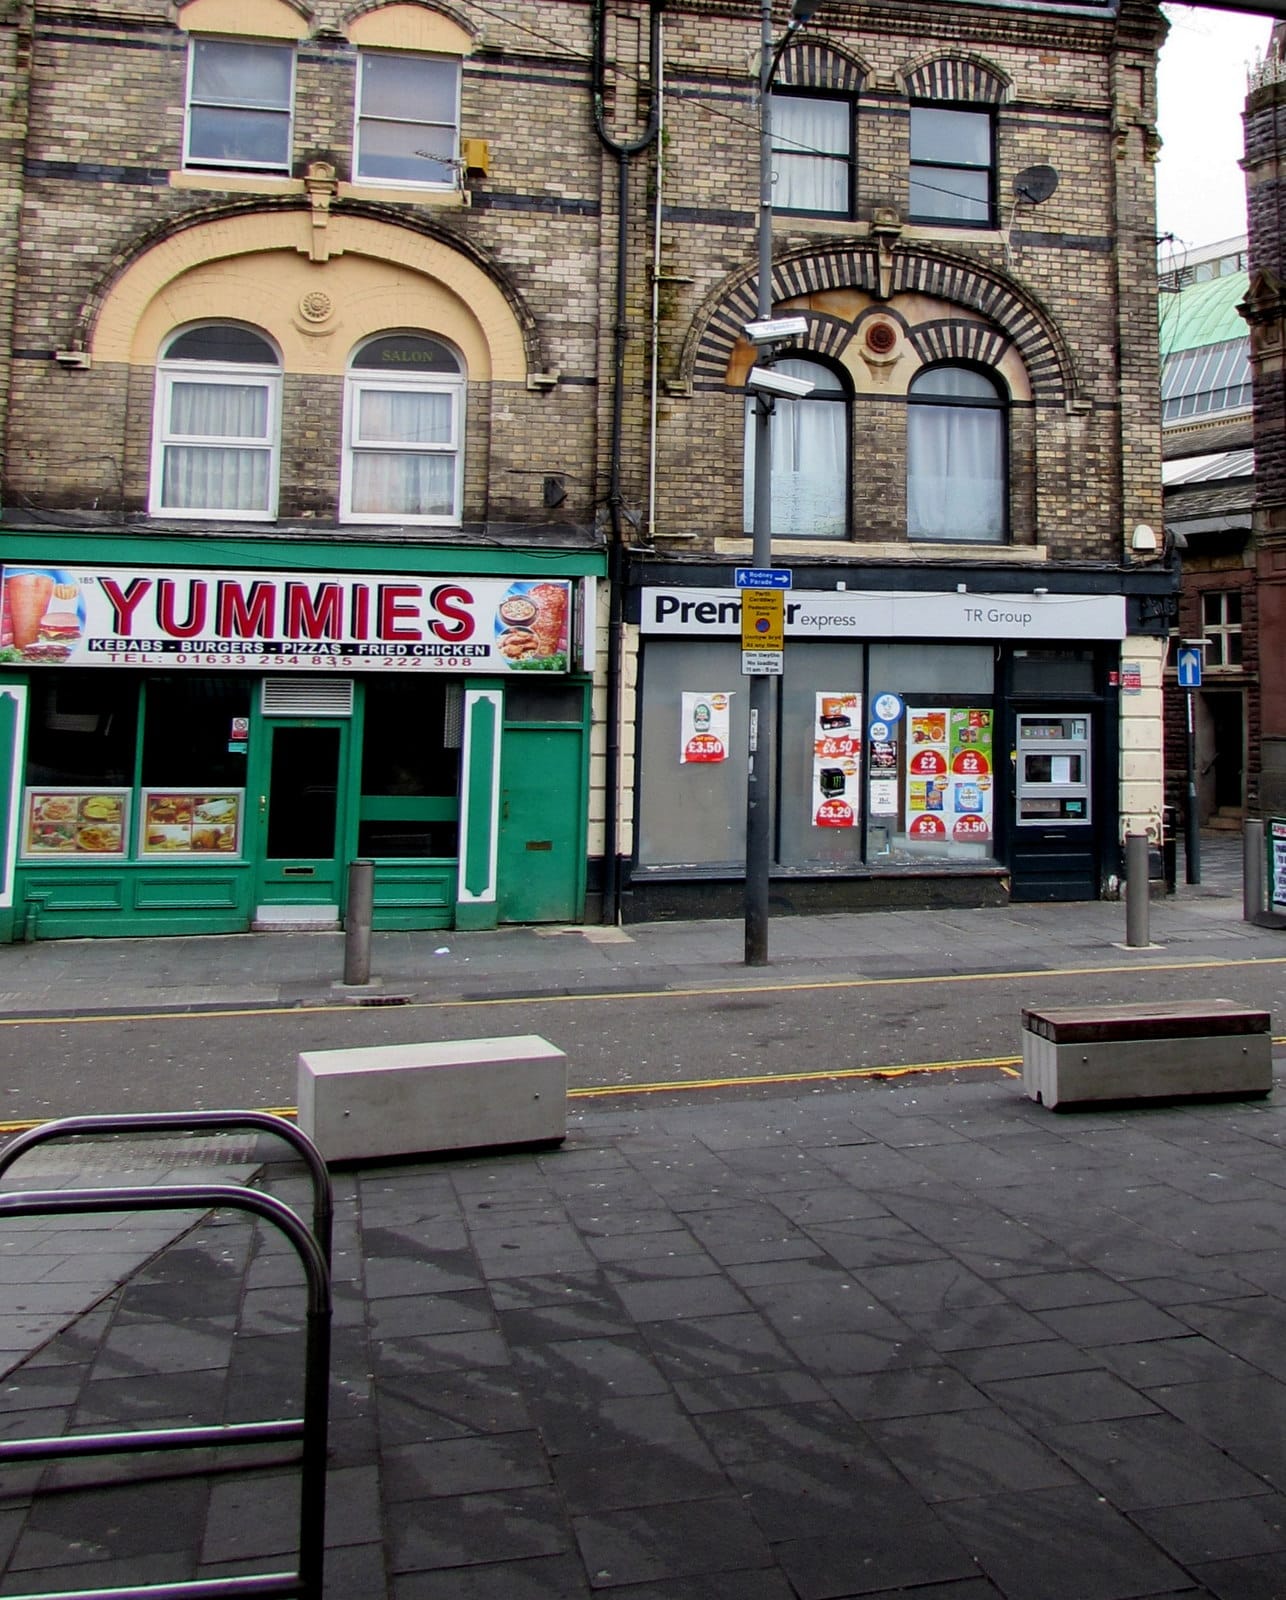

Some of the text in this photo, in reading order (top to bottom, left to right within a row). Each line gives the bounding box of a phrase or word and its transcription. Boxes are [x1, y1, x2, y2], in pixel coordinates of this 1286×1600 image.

[382, 350, 433, 362] SALON
[79, 576, 94, 585] 185
[749, 571, 773, 579] Rodney
[97, 576, 475, 643] YUMMIES
[655, 595, 856, 630] Premr express
[964, 609, 1032, 627] TR Group
[92, 639, 163, 651] KEBABS
[181, 640, 265, 653] BURGERS
[282, 642, 342, 655] PIZZAS
[358, 644, 407, 656] FRIED
[413, 644, 486, 656] CHICKEN
[107, 653, 473, 667] TEL: 01633 254 835 222 308
[688, 741, 722, 753] £3.50
[822, 740, 854, 754] £6.50
[920, 757, 937, 769] £2
[963, 758, 978, 770] £2
[820, 806, 851, 818] £3.29
[919, 821, 937, 833] £3
[955, 822, 986, 833] £3.50
